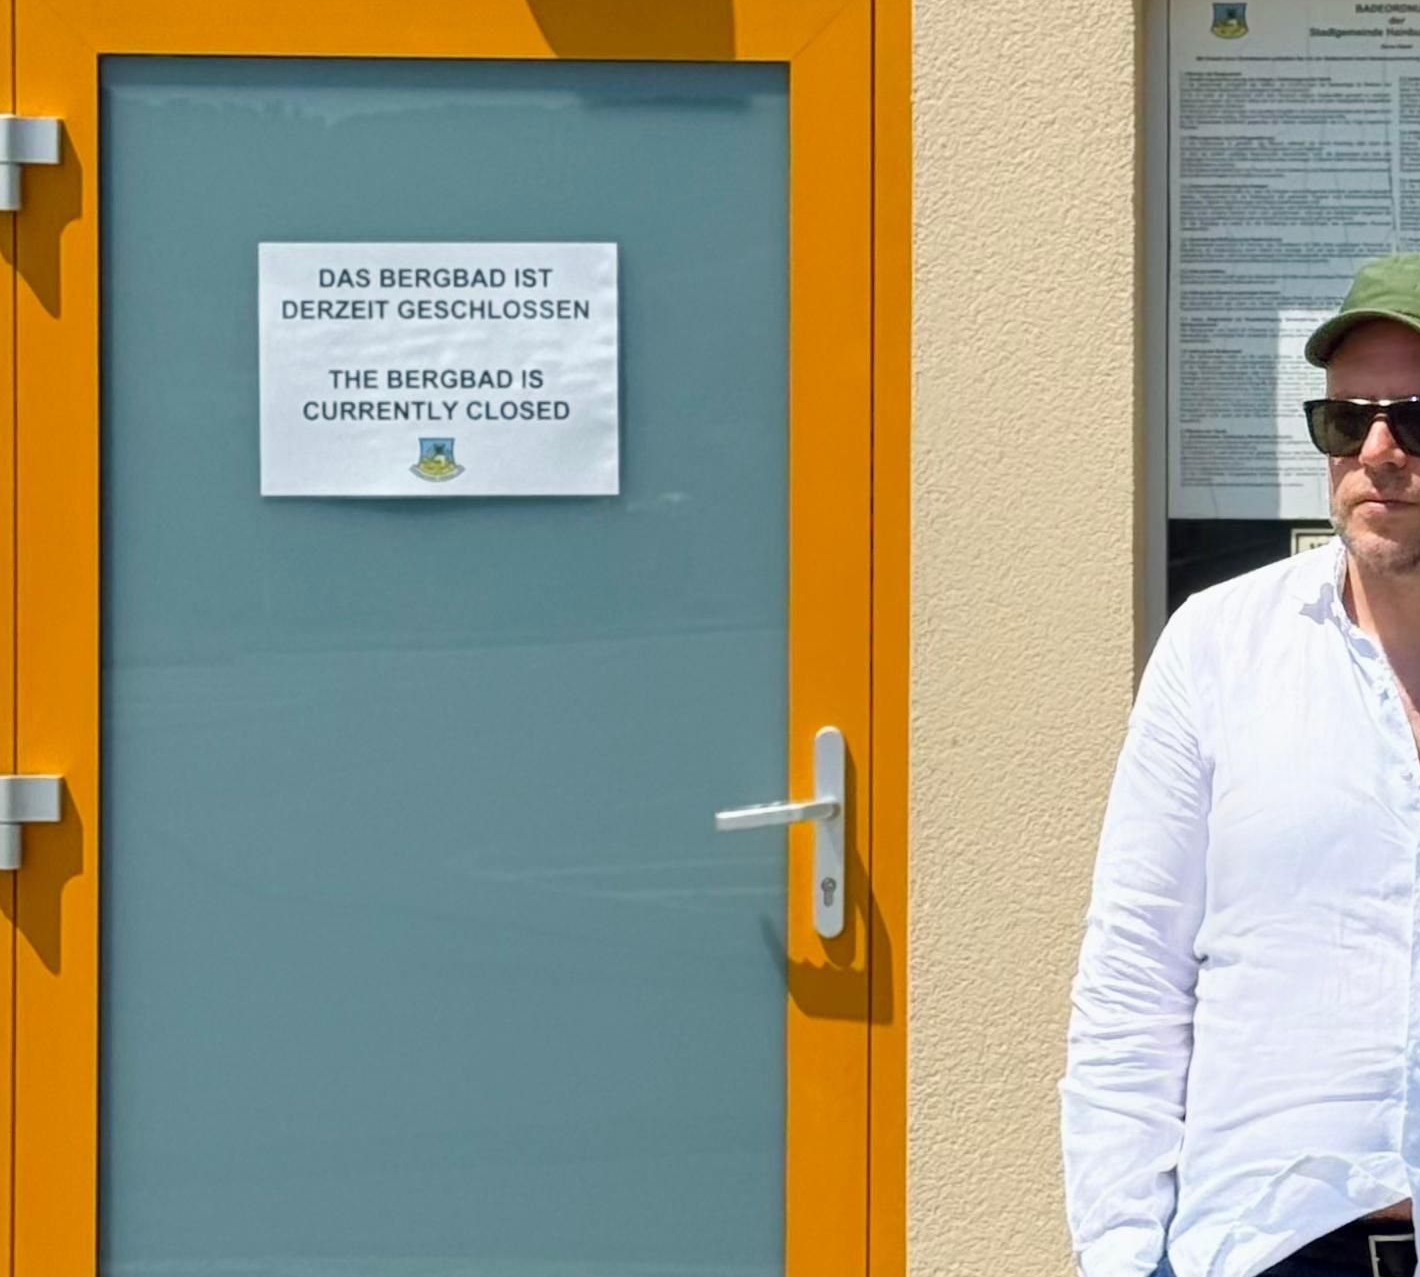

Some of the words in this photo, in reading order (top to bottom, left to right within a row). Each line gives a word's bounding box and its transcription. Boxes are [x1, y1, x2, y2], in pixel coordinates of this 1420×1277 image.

[319, 268, 371, 288] DAS
[380, 268, 506, 288] BERGBAD
[515, 268, 553, 288] IST
[282, 300, 389, 319] DERZEIT
[398, 300, 589, 319] GESCHLOSSEN
[329, 370, 378, 389] THE
[387, 369, 513, 389] BERGBAD
[522, 369, 543, 389] IS
[303, 401, 458, 421] CURRENTLY
[466, 401, 570, 420] CLOSED
